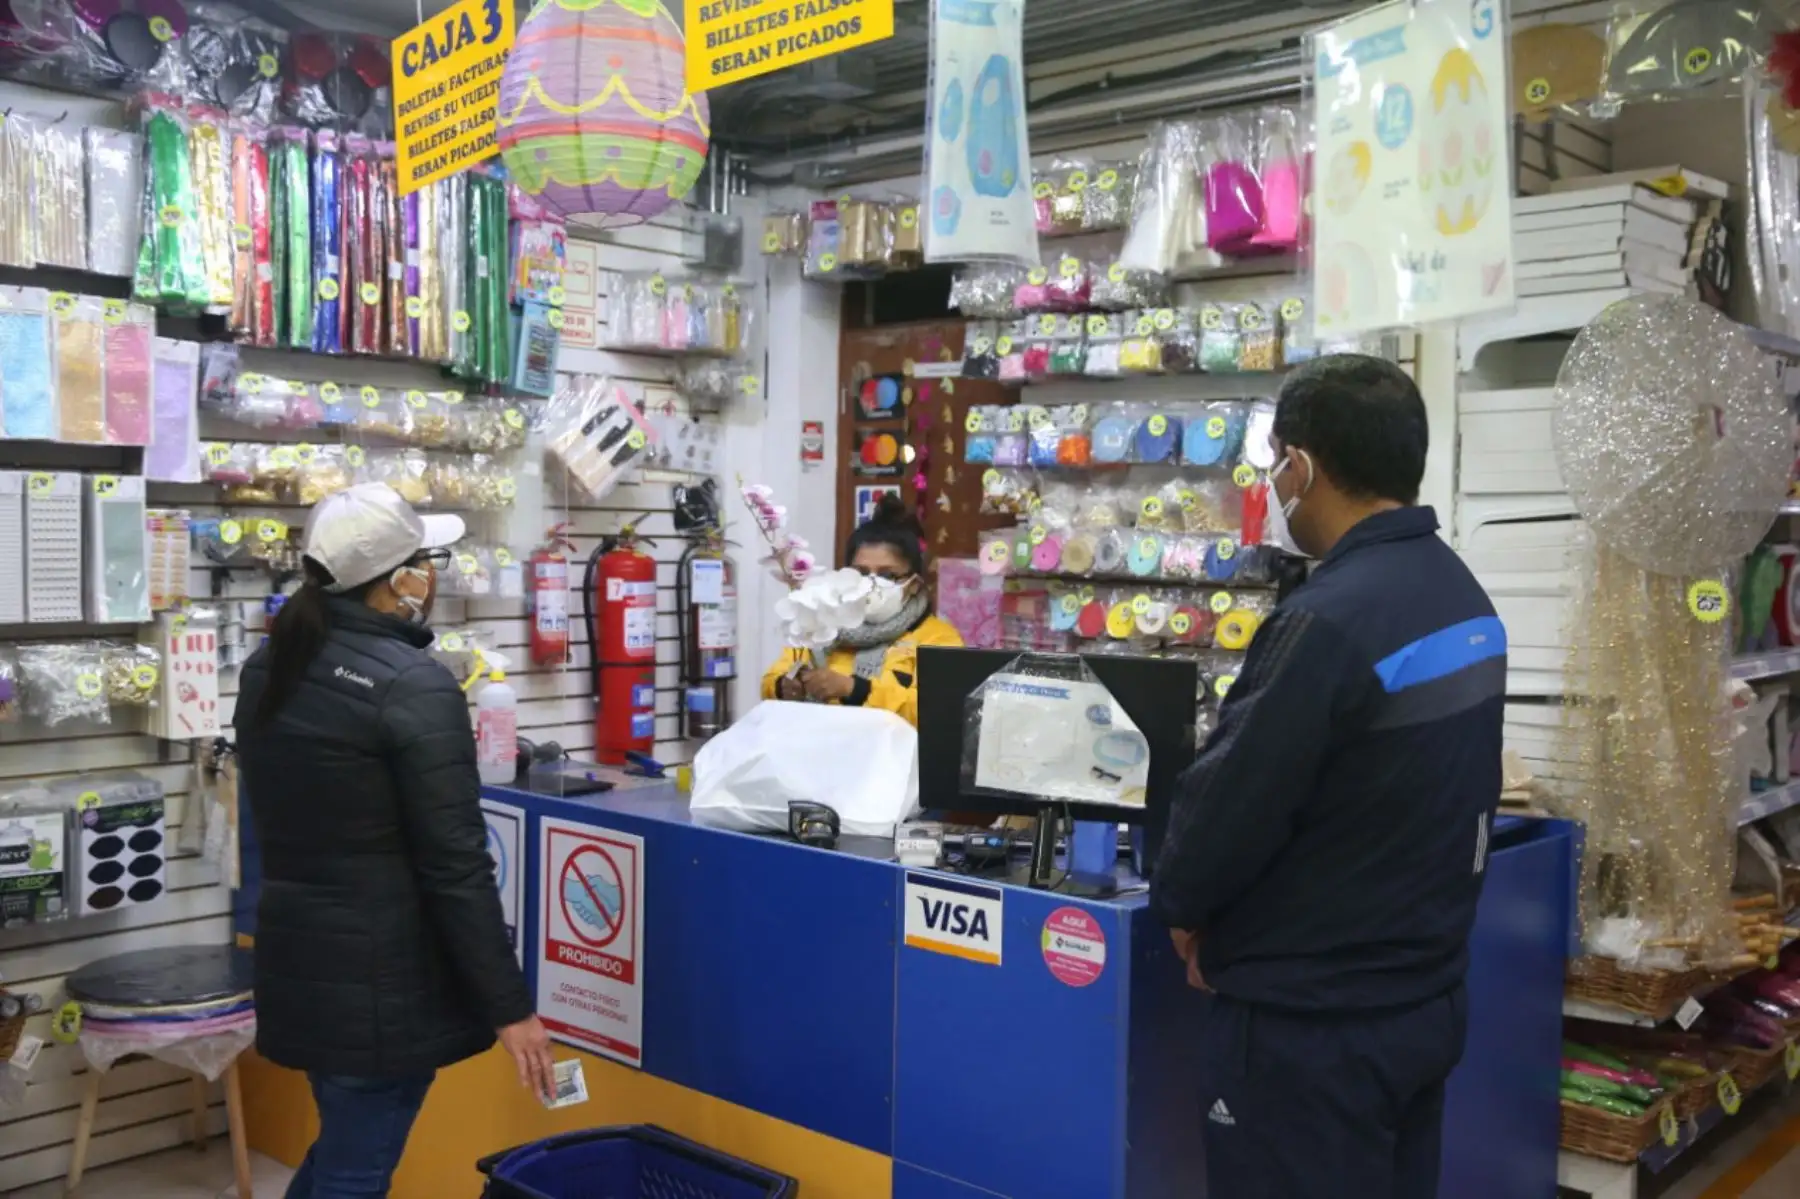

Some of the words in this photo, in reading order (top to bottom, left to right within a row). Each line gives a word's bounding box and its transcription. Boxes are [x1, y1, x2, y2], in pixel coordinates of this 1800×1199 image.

[401, 11, 476, 78] CAJA
[482, 0, 503, 44] 3
[706, 9, 790, 49] BILLETES
[794, 0, 865, 21] FALS
[711, 43, 771, 76] SERAN
[776, 15, 862, 57] PICADOS
[404, 107, 442, 138] REVISE
[443, 99, 459, 118] SU
[408, 124, 458, 159] BILLETES
[412, 152, 448, 181] SERAN
[916, 895, 989, 942] VISA
[559, 945, 623, 976] PROHIBIDO
[551, 992, 567, 1005] CON
[568, 998, 592, 1014] OTRAS
[591, 1003, 630, 1025] PERSONAS
[560, 982, 598, 1001] CONTACTO
